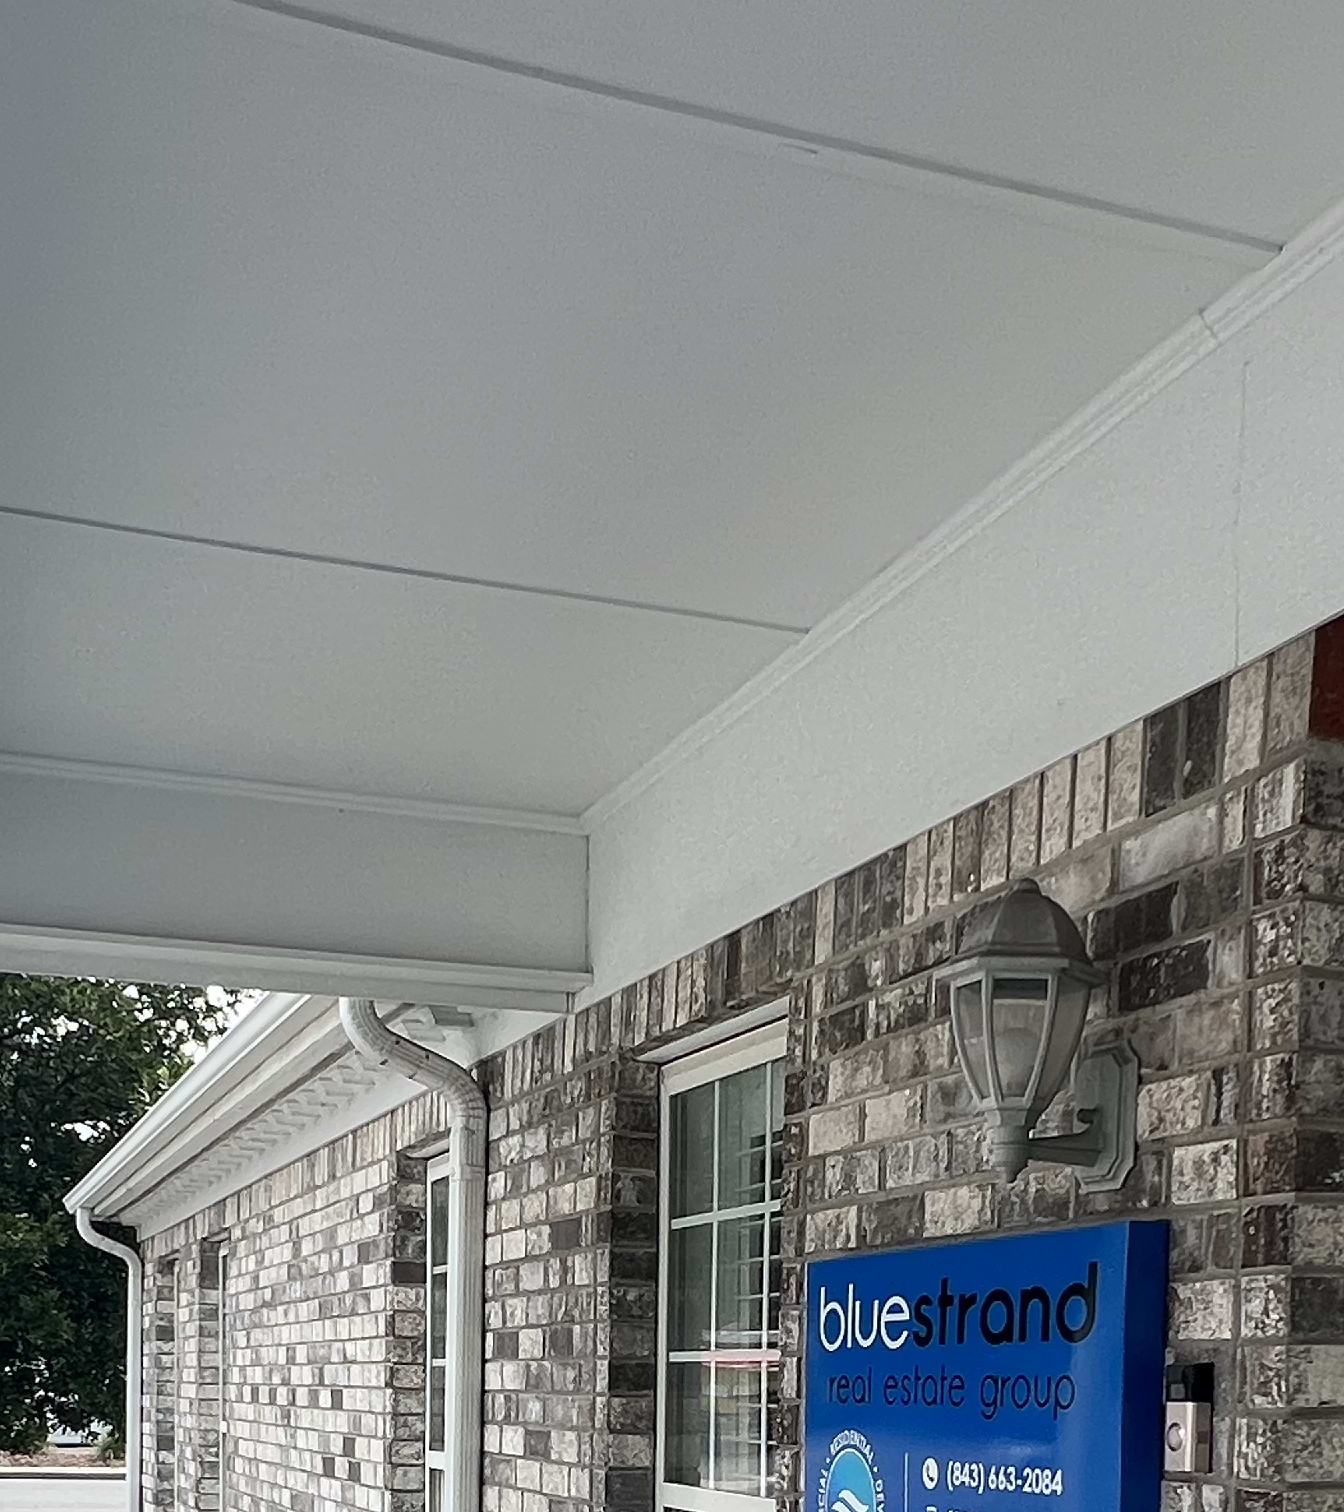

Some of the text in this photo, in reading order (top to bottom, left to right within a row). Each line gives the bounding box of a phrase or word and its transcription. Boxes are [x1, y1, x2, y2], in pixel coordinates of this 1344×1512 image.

[819, 1261, 1098, 1352] bluestrand
[828, 1364, 1076, 1420] real estate group
[946, 1461, 1063, 1496] (843) 663-2084
